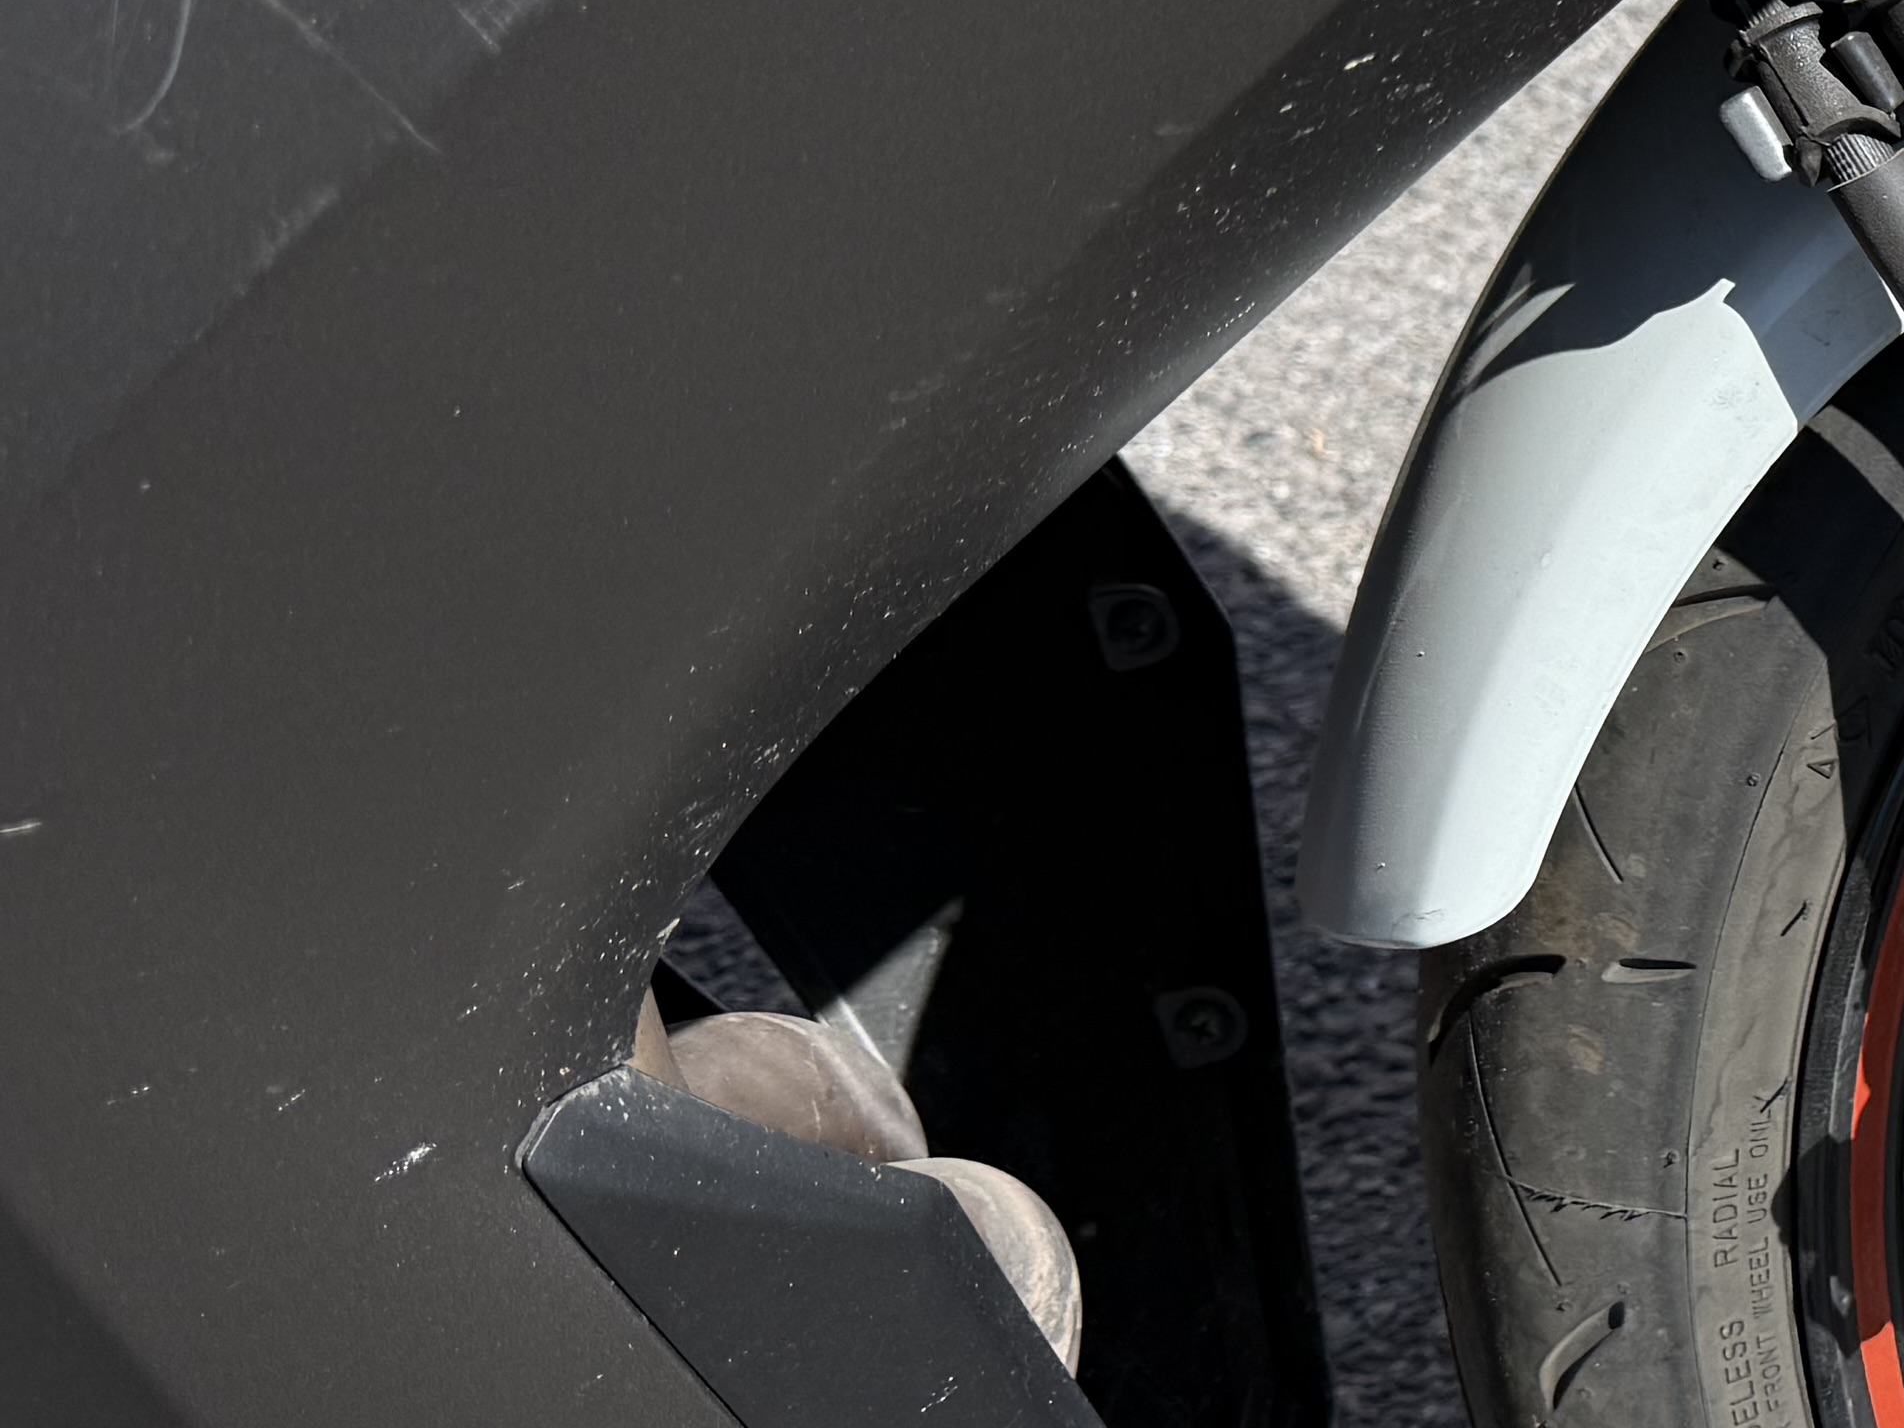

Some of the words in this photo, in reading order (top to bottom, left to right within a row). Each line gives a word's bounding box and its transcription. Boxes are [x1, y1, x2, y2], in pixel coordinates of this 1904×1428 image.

[1748, 1094, 1771, 1158] ONLY
[1712, 1149, 1741, 1269] RADIAL
[1747, 1173, 1769, 1225] USE
[1748, 1236, 1773, 1319] WHEEL
[1756, 1333, 1782, 1414] FRONT
